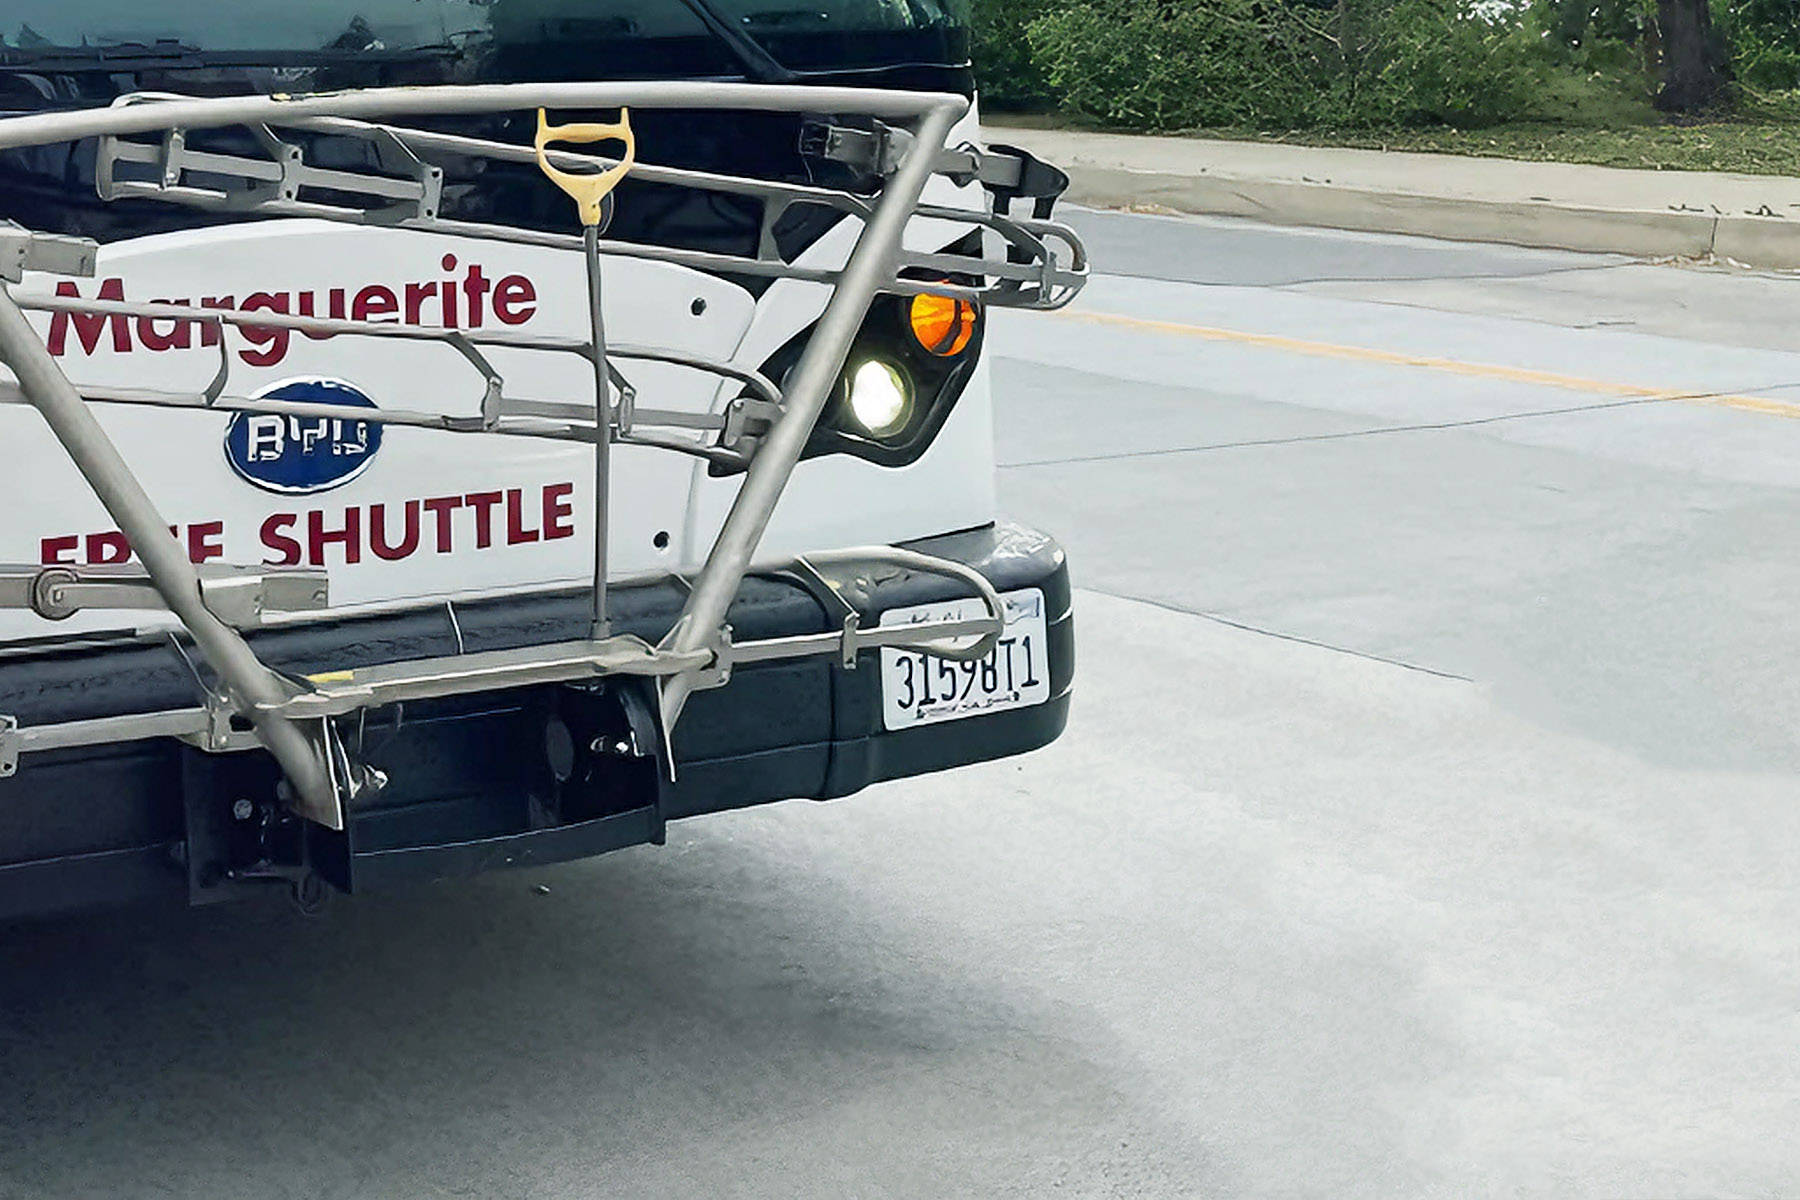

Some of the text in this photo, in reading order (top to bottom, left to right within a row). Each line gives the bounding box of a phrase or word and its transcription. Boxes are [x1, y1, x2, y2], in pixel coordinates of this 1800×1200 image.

[47, 253, 538, 368] Marguerite
[247, 412, 368, 463] BYD
[41, 482, 575, 567] FRE SHUTTLE
[895, 635, 1040, 710] 31598T1
